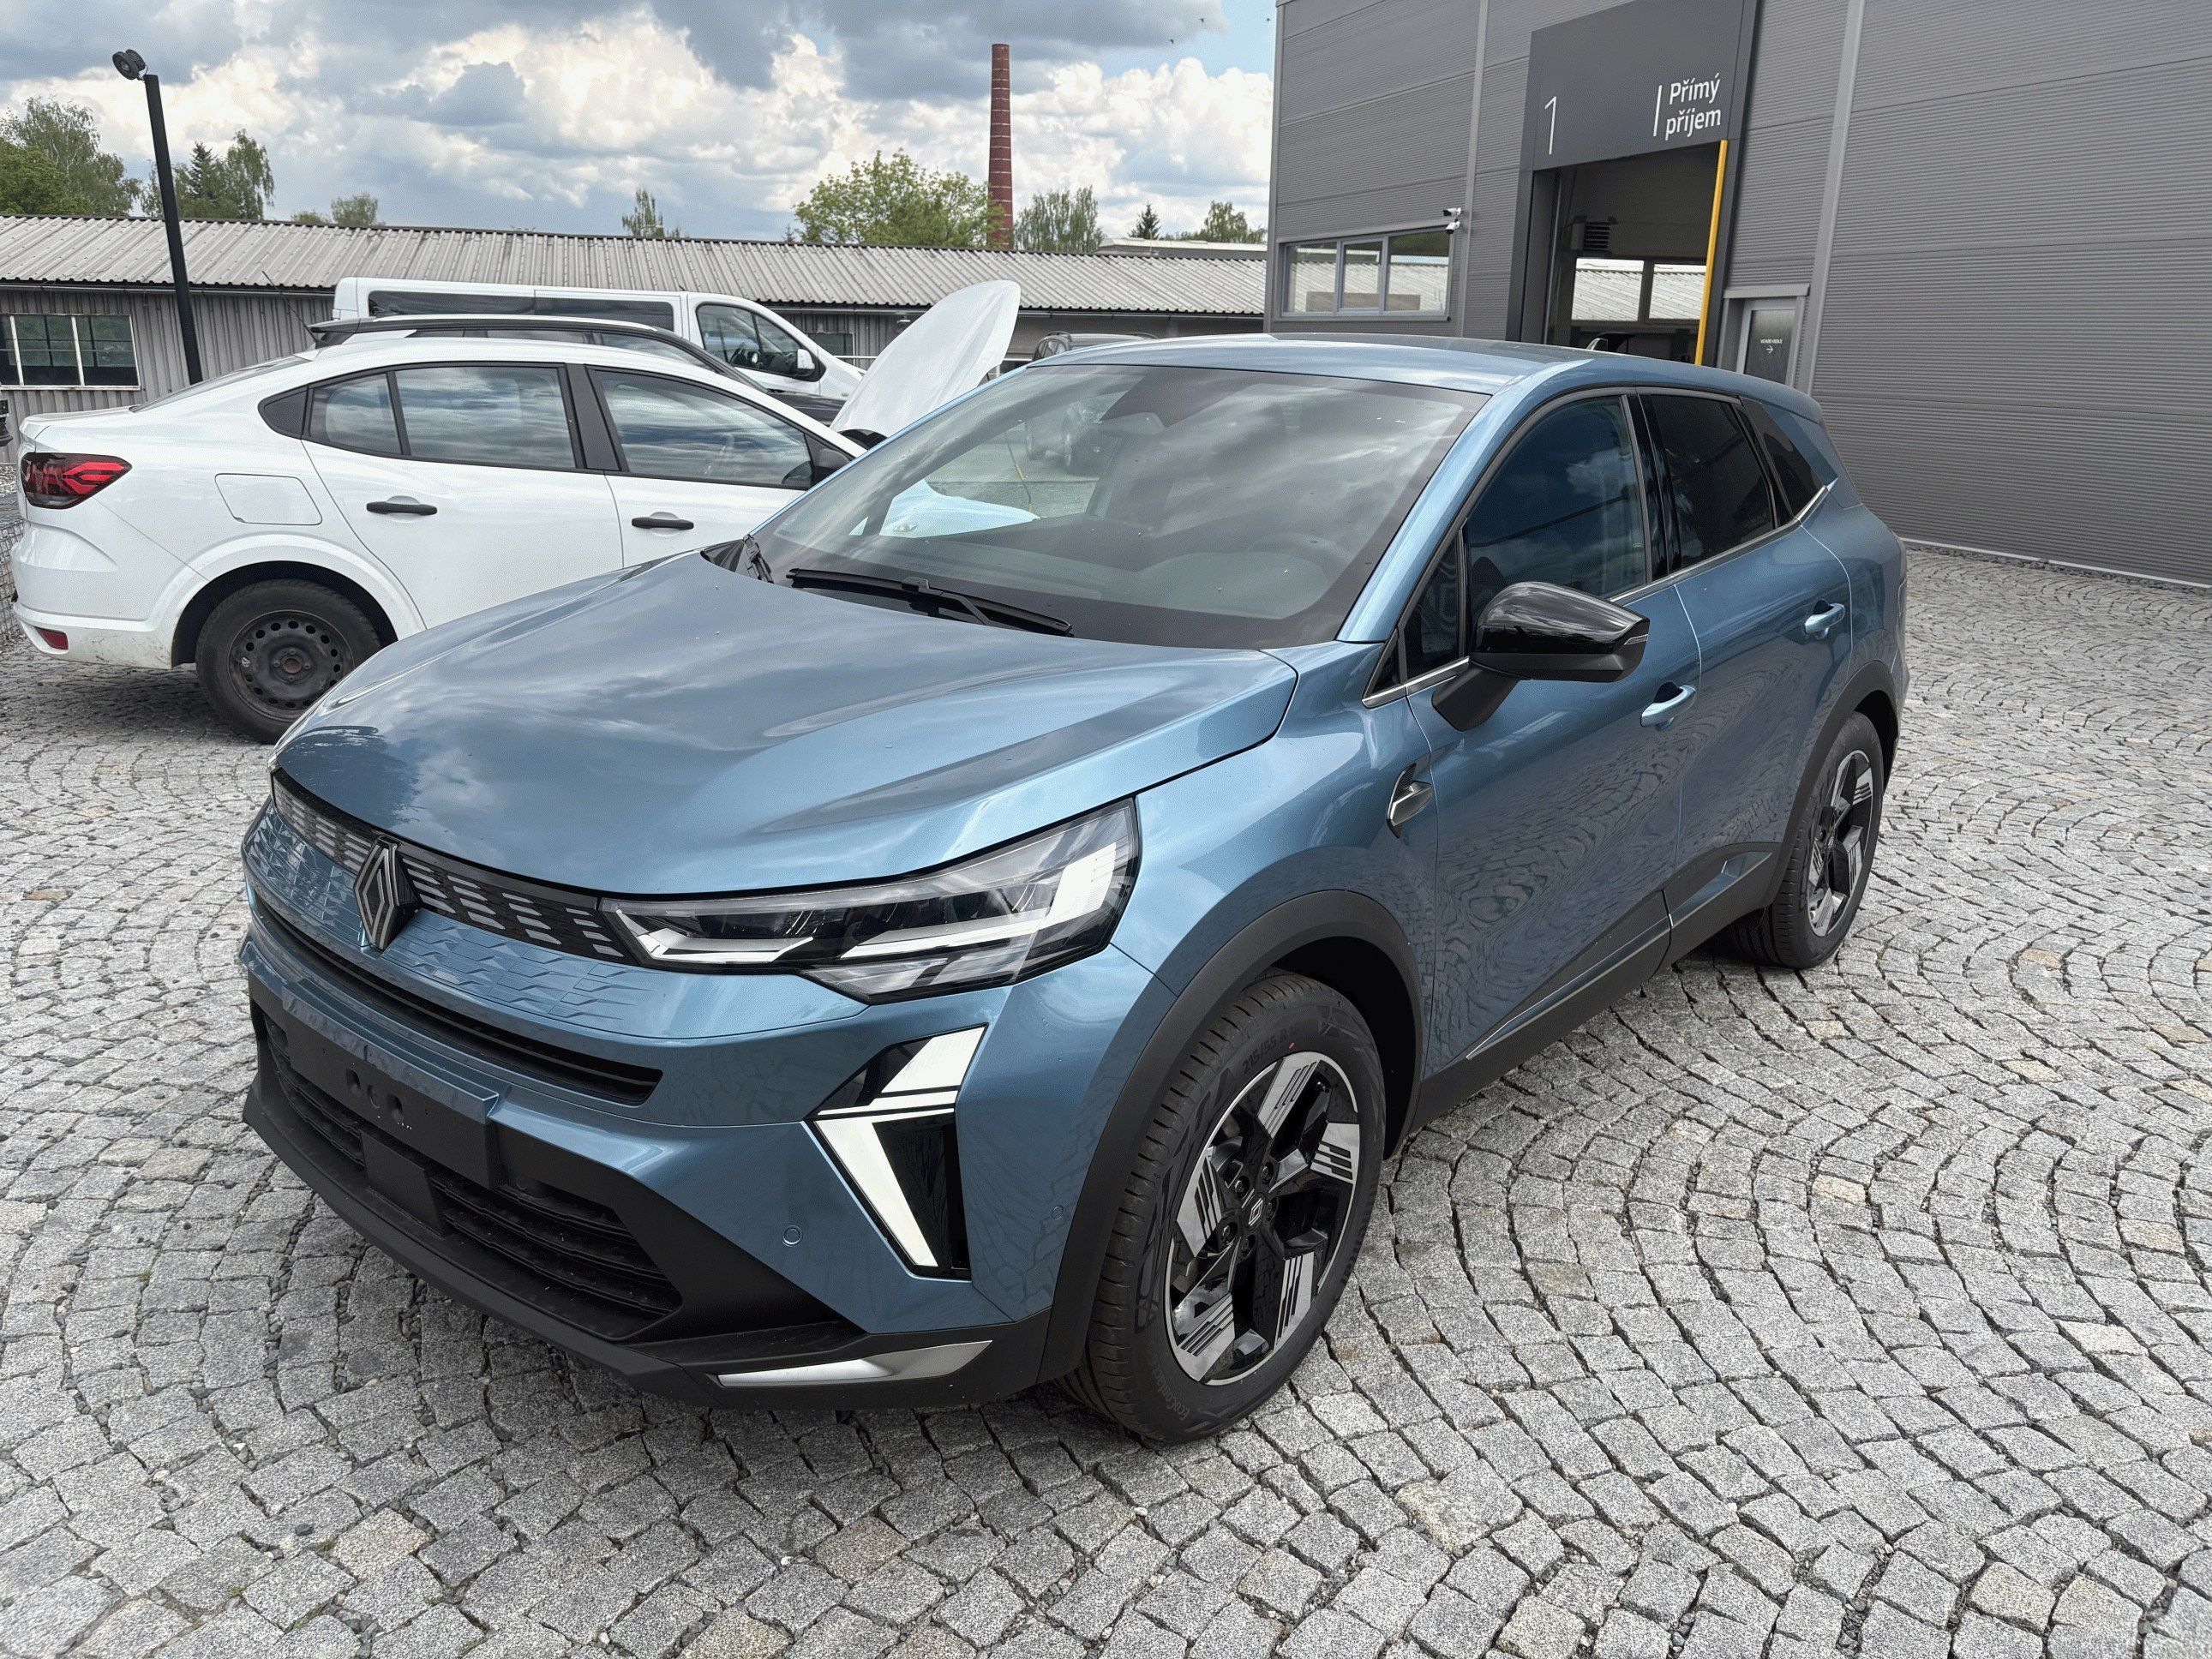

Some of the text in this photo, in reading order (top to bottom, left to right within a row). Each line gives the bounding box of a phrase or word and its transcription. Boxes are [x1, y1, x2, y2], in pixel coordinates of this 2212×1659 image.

[1669, 72, 1720, 105] Přímý
[1544, 96, 1557, 155] 1
[1665, 108, 1721, 141] příjem
